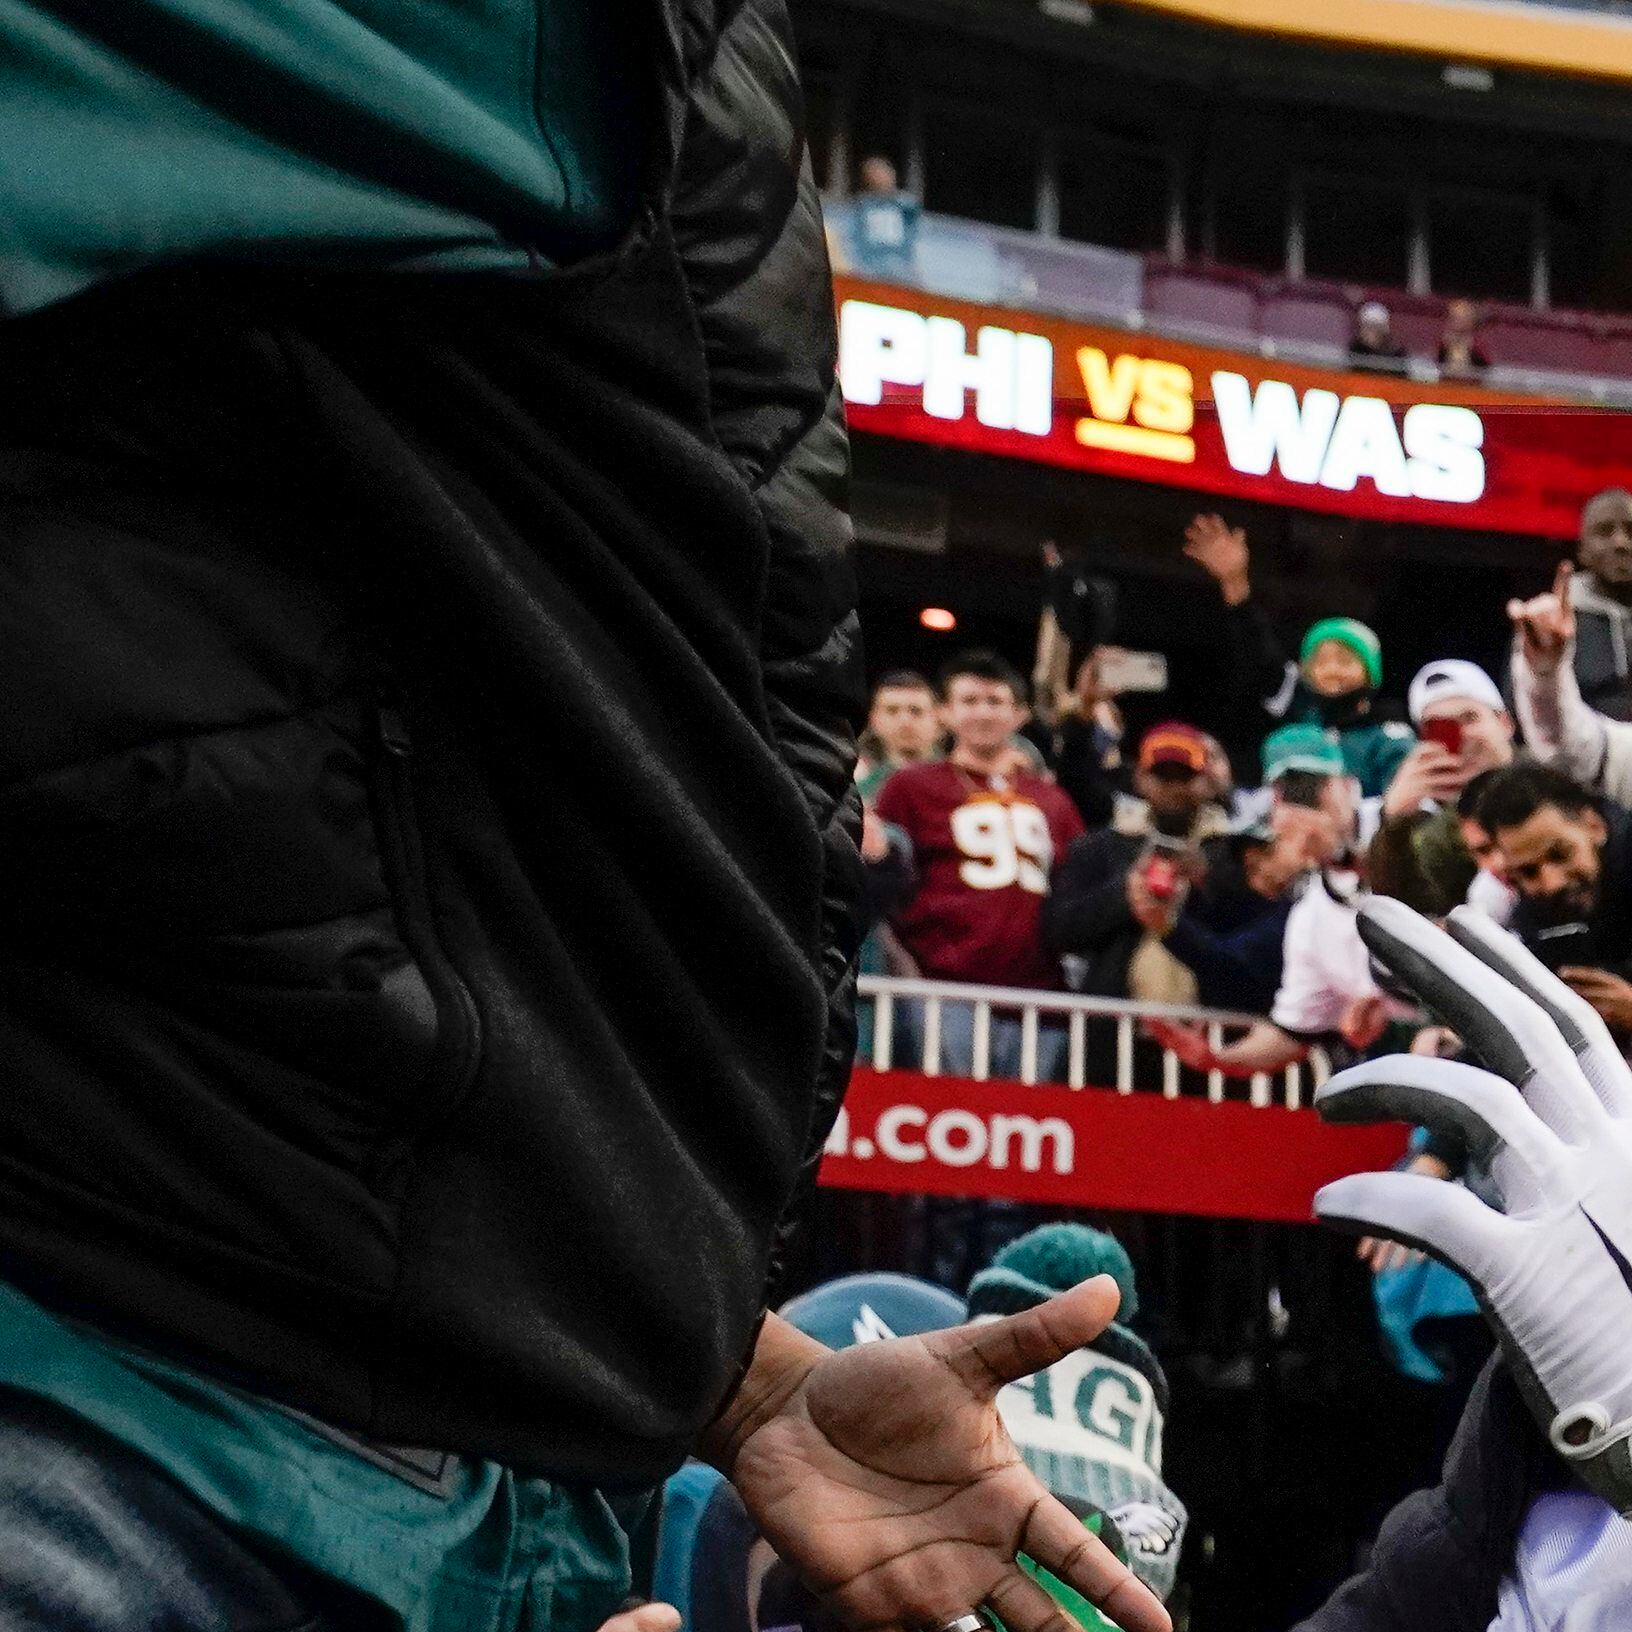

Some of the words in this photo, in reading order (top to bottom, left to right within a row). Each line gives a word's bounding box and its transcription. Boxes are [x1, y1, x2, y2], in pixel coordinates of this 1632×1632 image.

[840, 299, 1053, 436] PHI
[1075, 345, 1195, 435] VS
[1210, 370, 1485, 503] WAS
[949, 801, 1055, 897] 99
